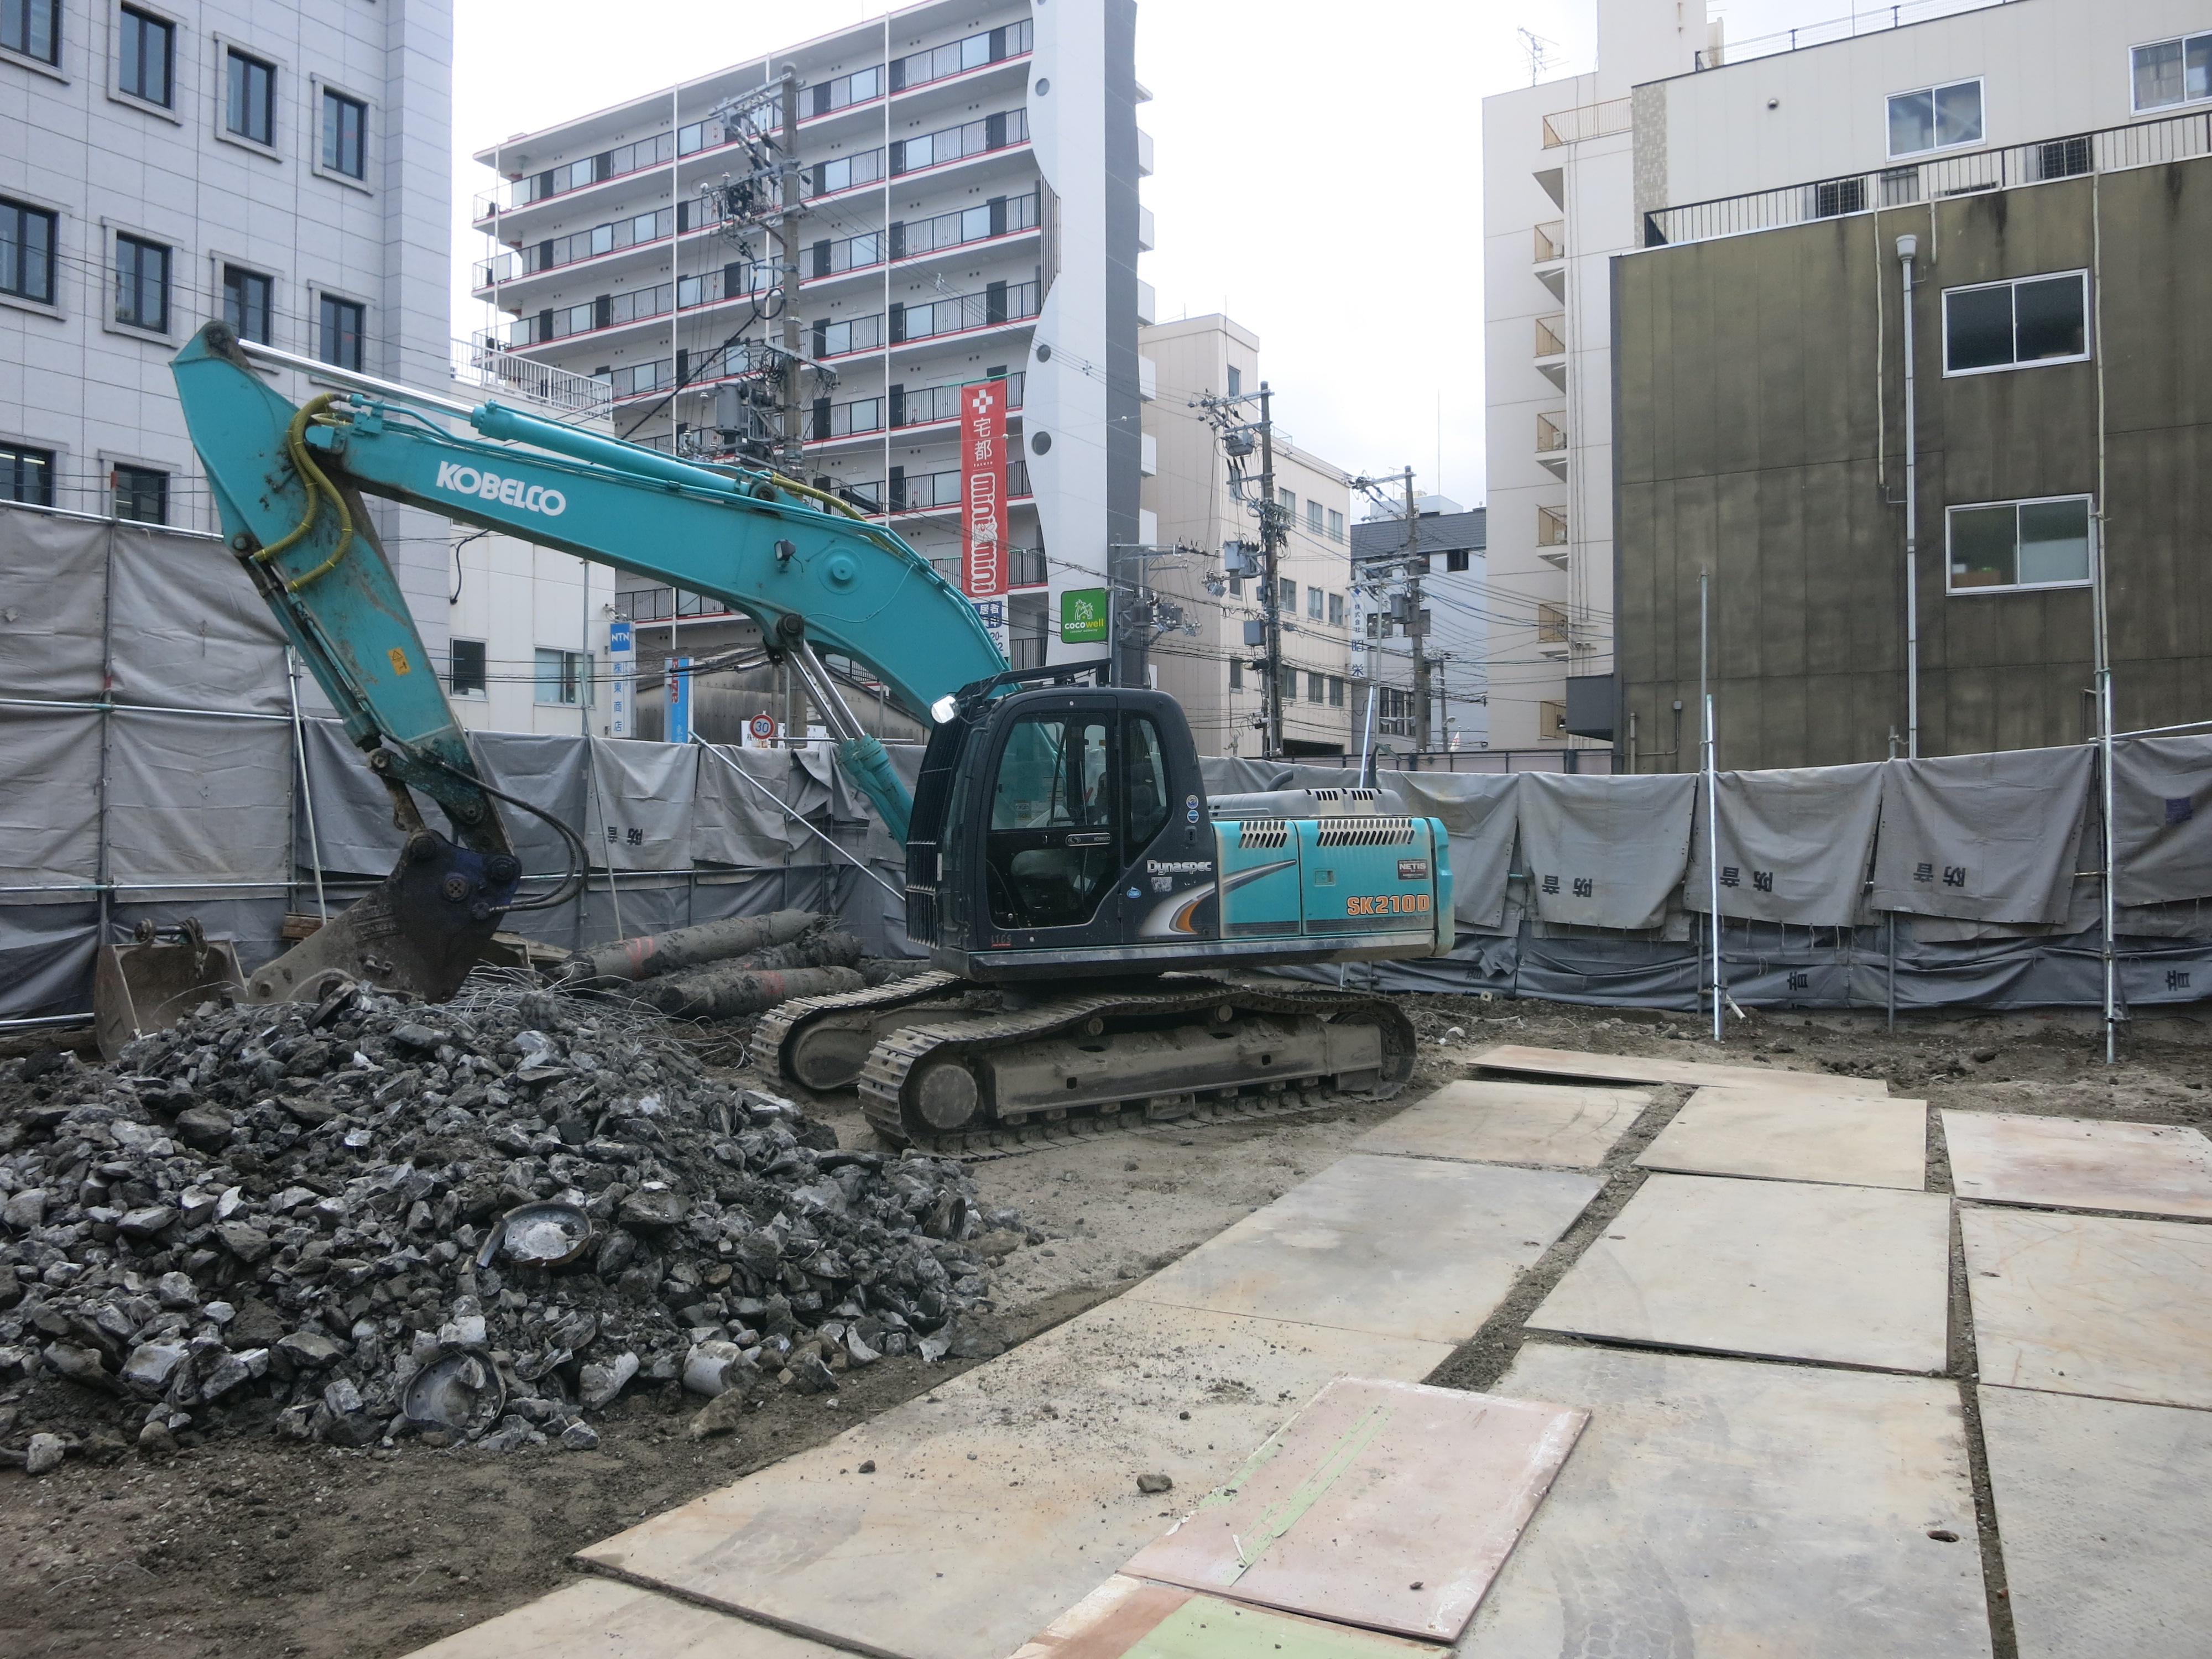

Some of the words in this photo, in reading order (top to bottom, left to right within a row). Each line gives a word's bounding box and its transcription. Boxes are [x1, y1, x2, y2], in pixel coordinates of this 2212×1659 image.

[973, 418, 992, 461] 宅都
[436, 461, 566, 516] KOBELCO
[1065, 618, 1104, 630] cocowell
[612, 632, 629, 642] NTN
[755, 721, 769, 733] 30
[1147, 860, 1212, 875] Dynaspec
[1913, 862, 1966, 887] 防音
[1542, 875, 1593, 898] 防音
[1720, 866, 1773, 892] 防音
[1347, 894, 1430, 916] SK210D
